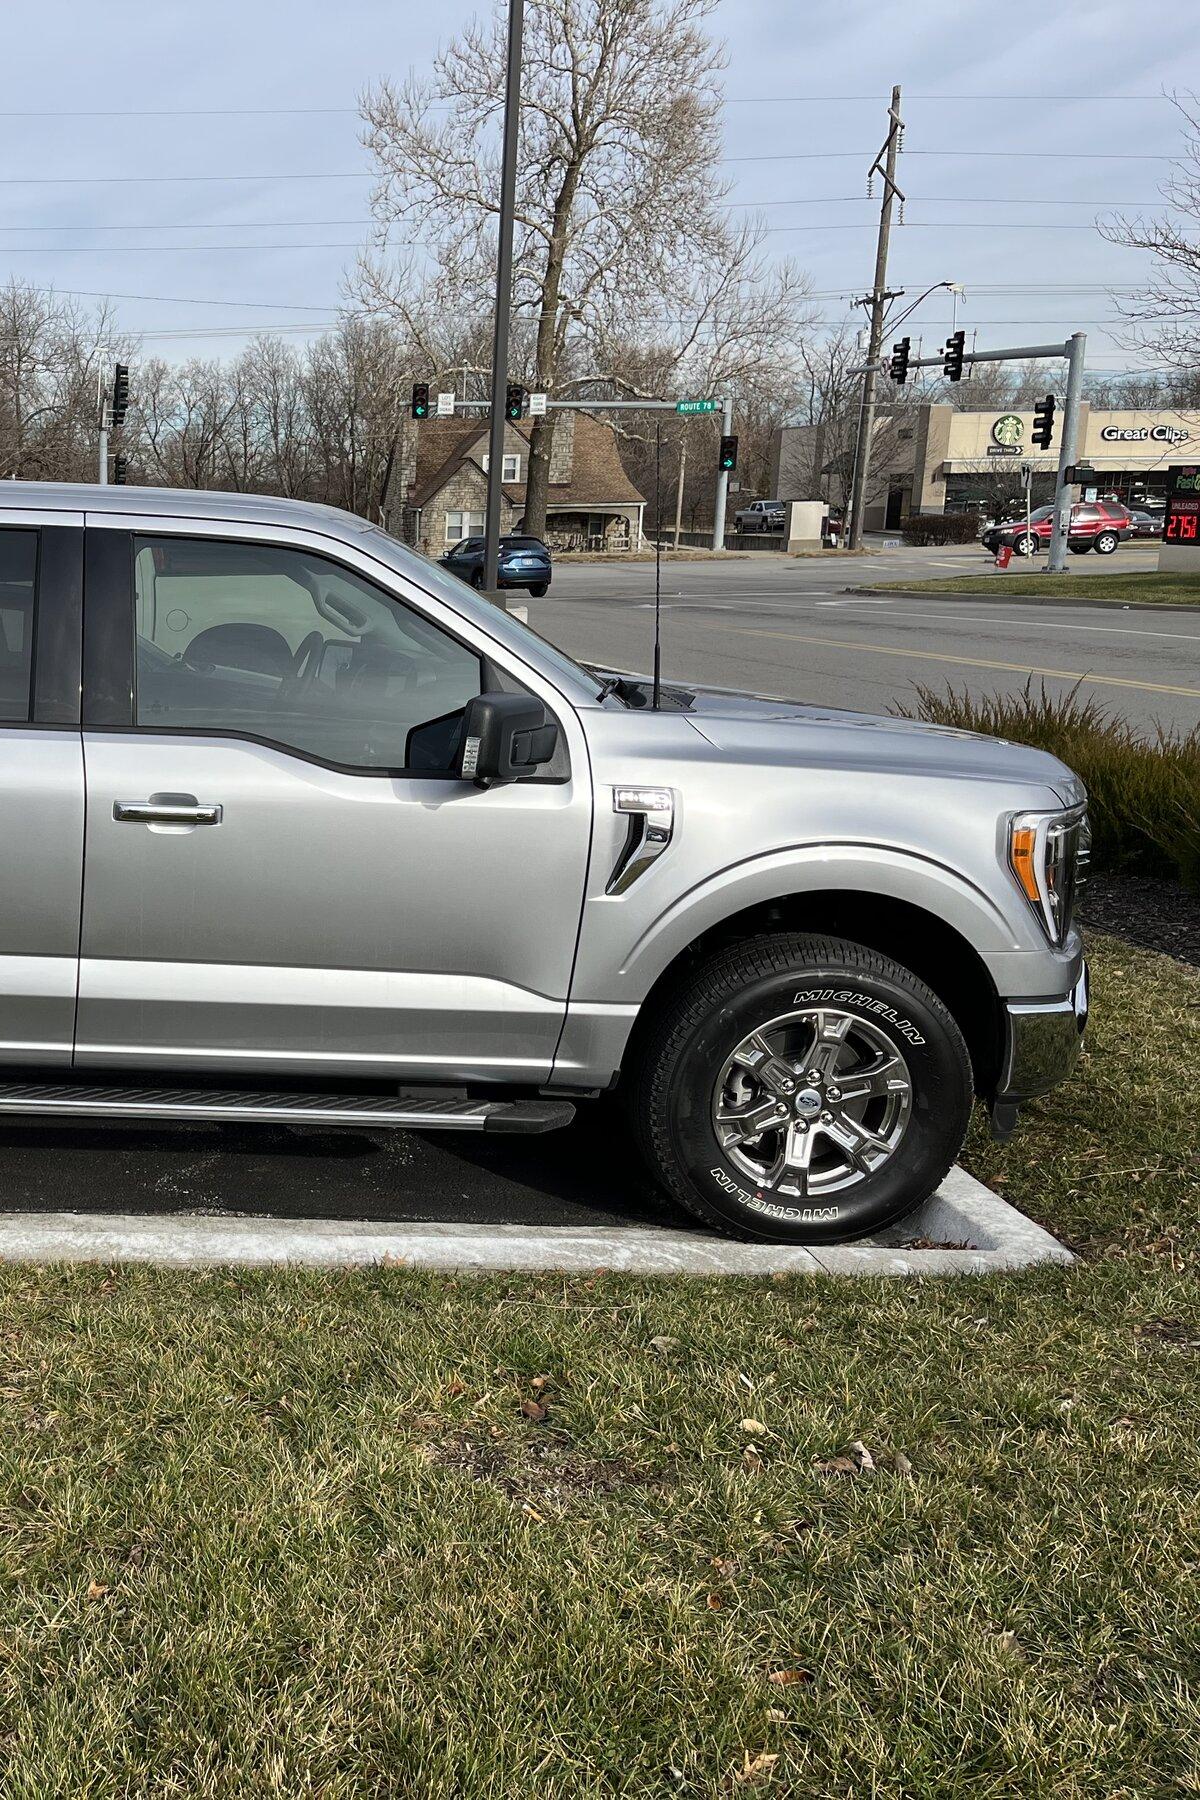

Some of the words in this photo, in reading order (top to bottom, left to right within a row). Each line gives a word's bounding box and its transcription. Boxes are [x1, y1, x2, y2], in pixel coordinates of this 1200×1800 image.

[680, 402, 700, 410] ROUTE
[1102, 425, 1147, 440] Great
[1151, 425, 1188, 443] Clips
[793, 989, 926, 1046] MICHELIN
[710, 1167, 839, 1221] MICHELIN
